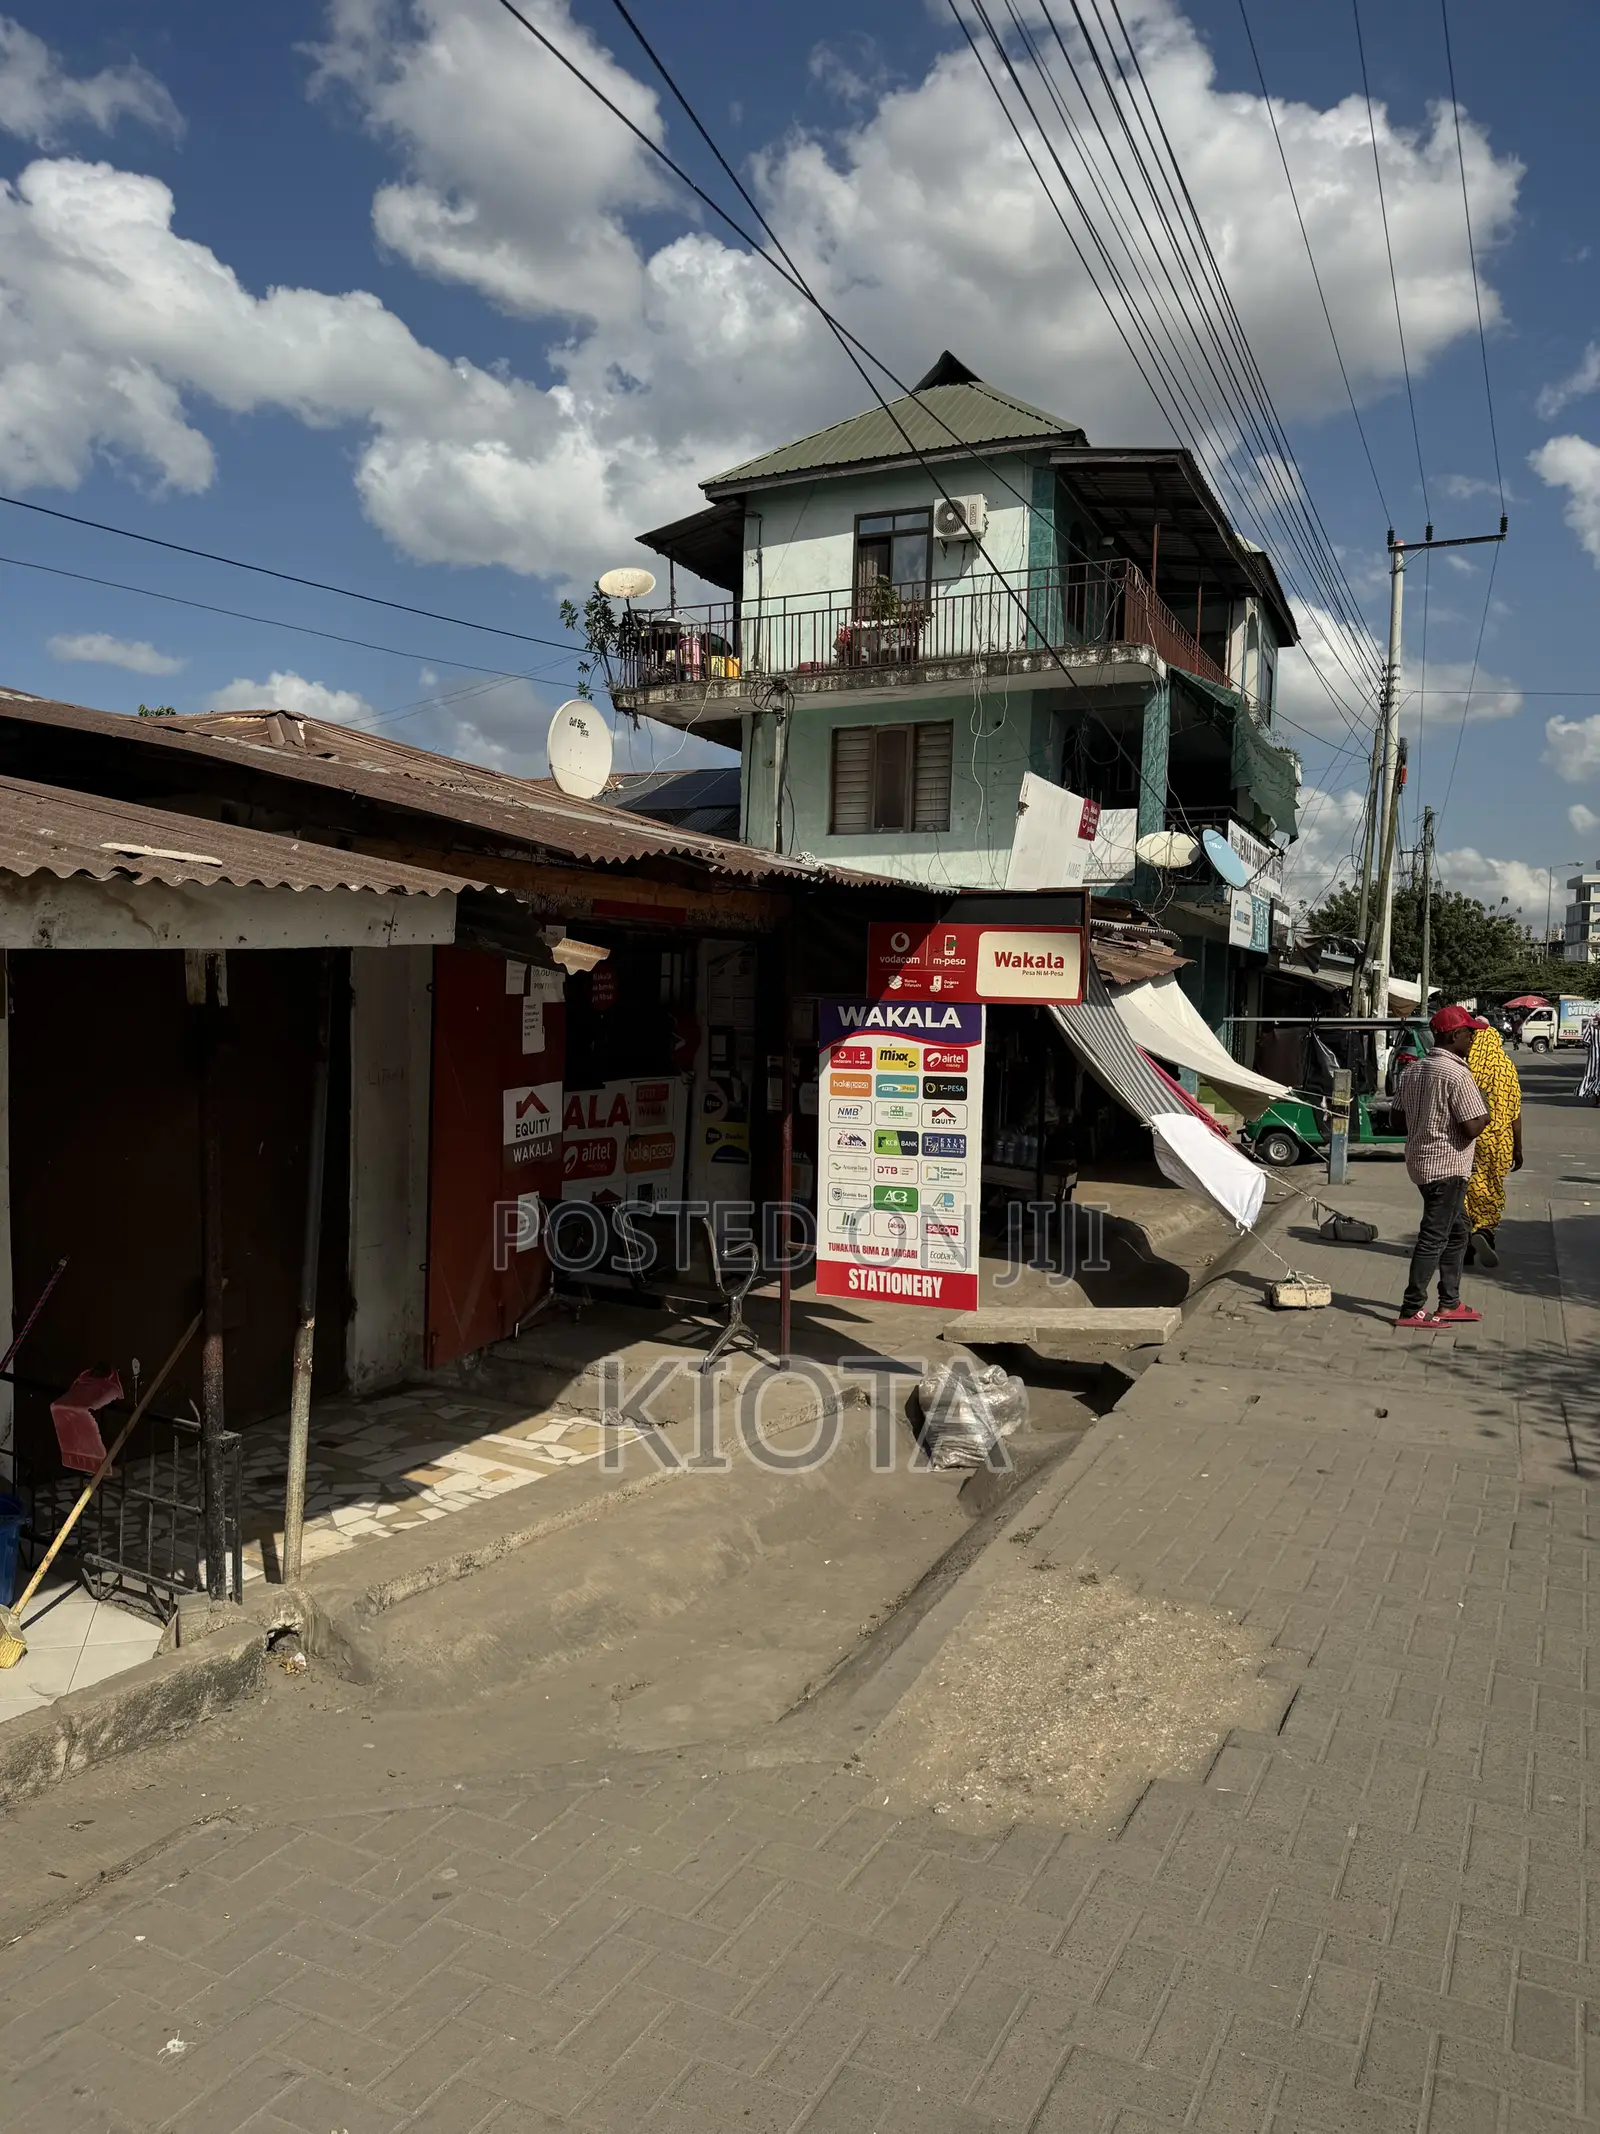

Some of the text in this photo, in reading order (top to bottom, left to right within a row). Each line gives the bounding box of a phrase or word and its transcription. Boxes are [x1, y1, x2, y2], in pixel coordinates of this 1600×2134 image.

[880, 955, 966, 967] vodacom m-pesa
[994, 951, 1065, 968] Wakala
[838, 1006, 961, 1028] WAKALA
[942, 1054, 964, 1063] airtel
[939, 1084, 965, 1093] T-PESA
[838, 1107, 859, 1116] NMB
[515, 1118, 551, 1138] EQUITY
[513, 1141, 553, 1163] WAKALA
[582, 1142, 611, 1162] airtel
[877, 1166, 898, 1175] DTB
[828, 1242, 918, 1259] TUNAKATA BIMA ZA MAGARI
[848, 1268, 943, 1299] STATIONERY
